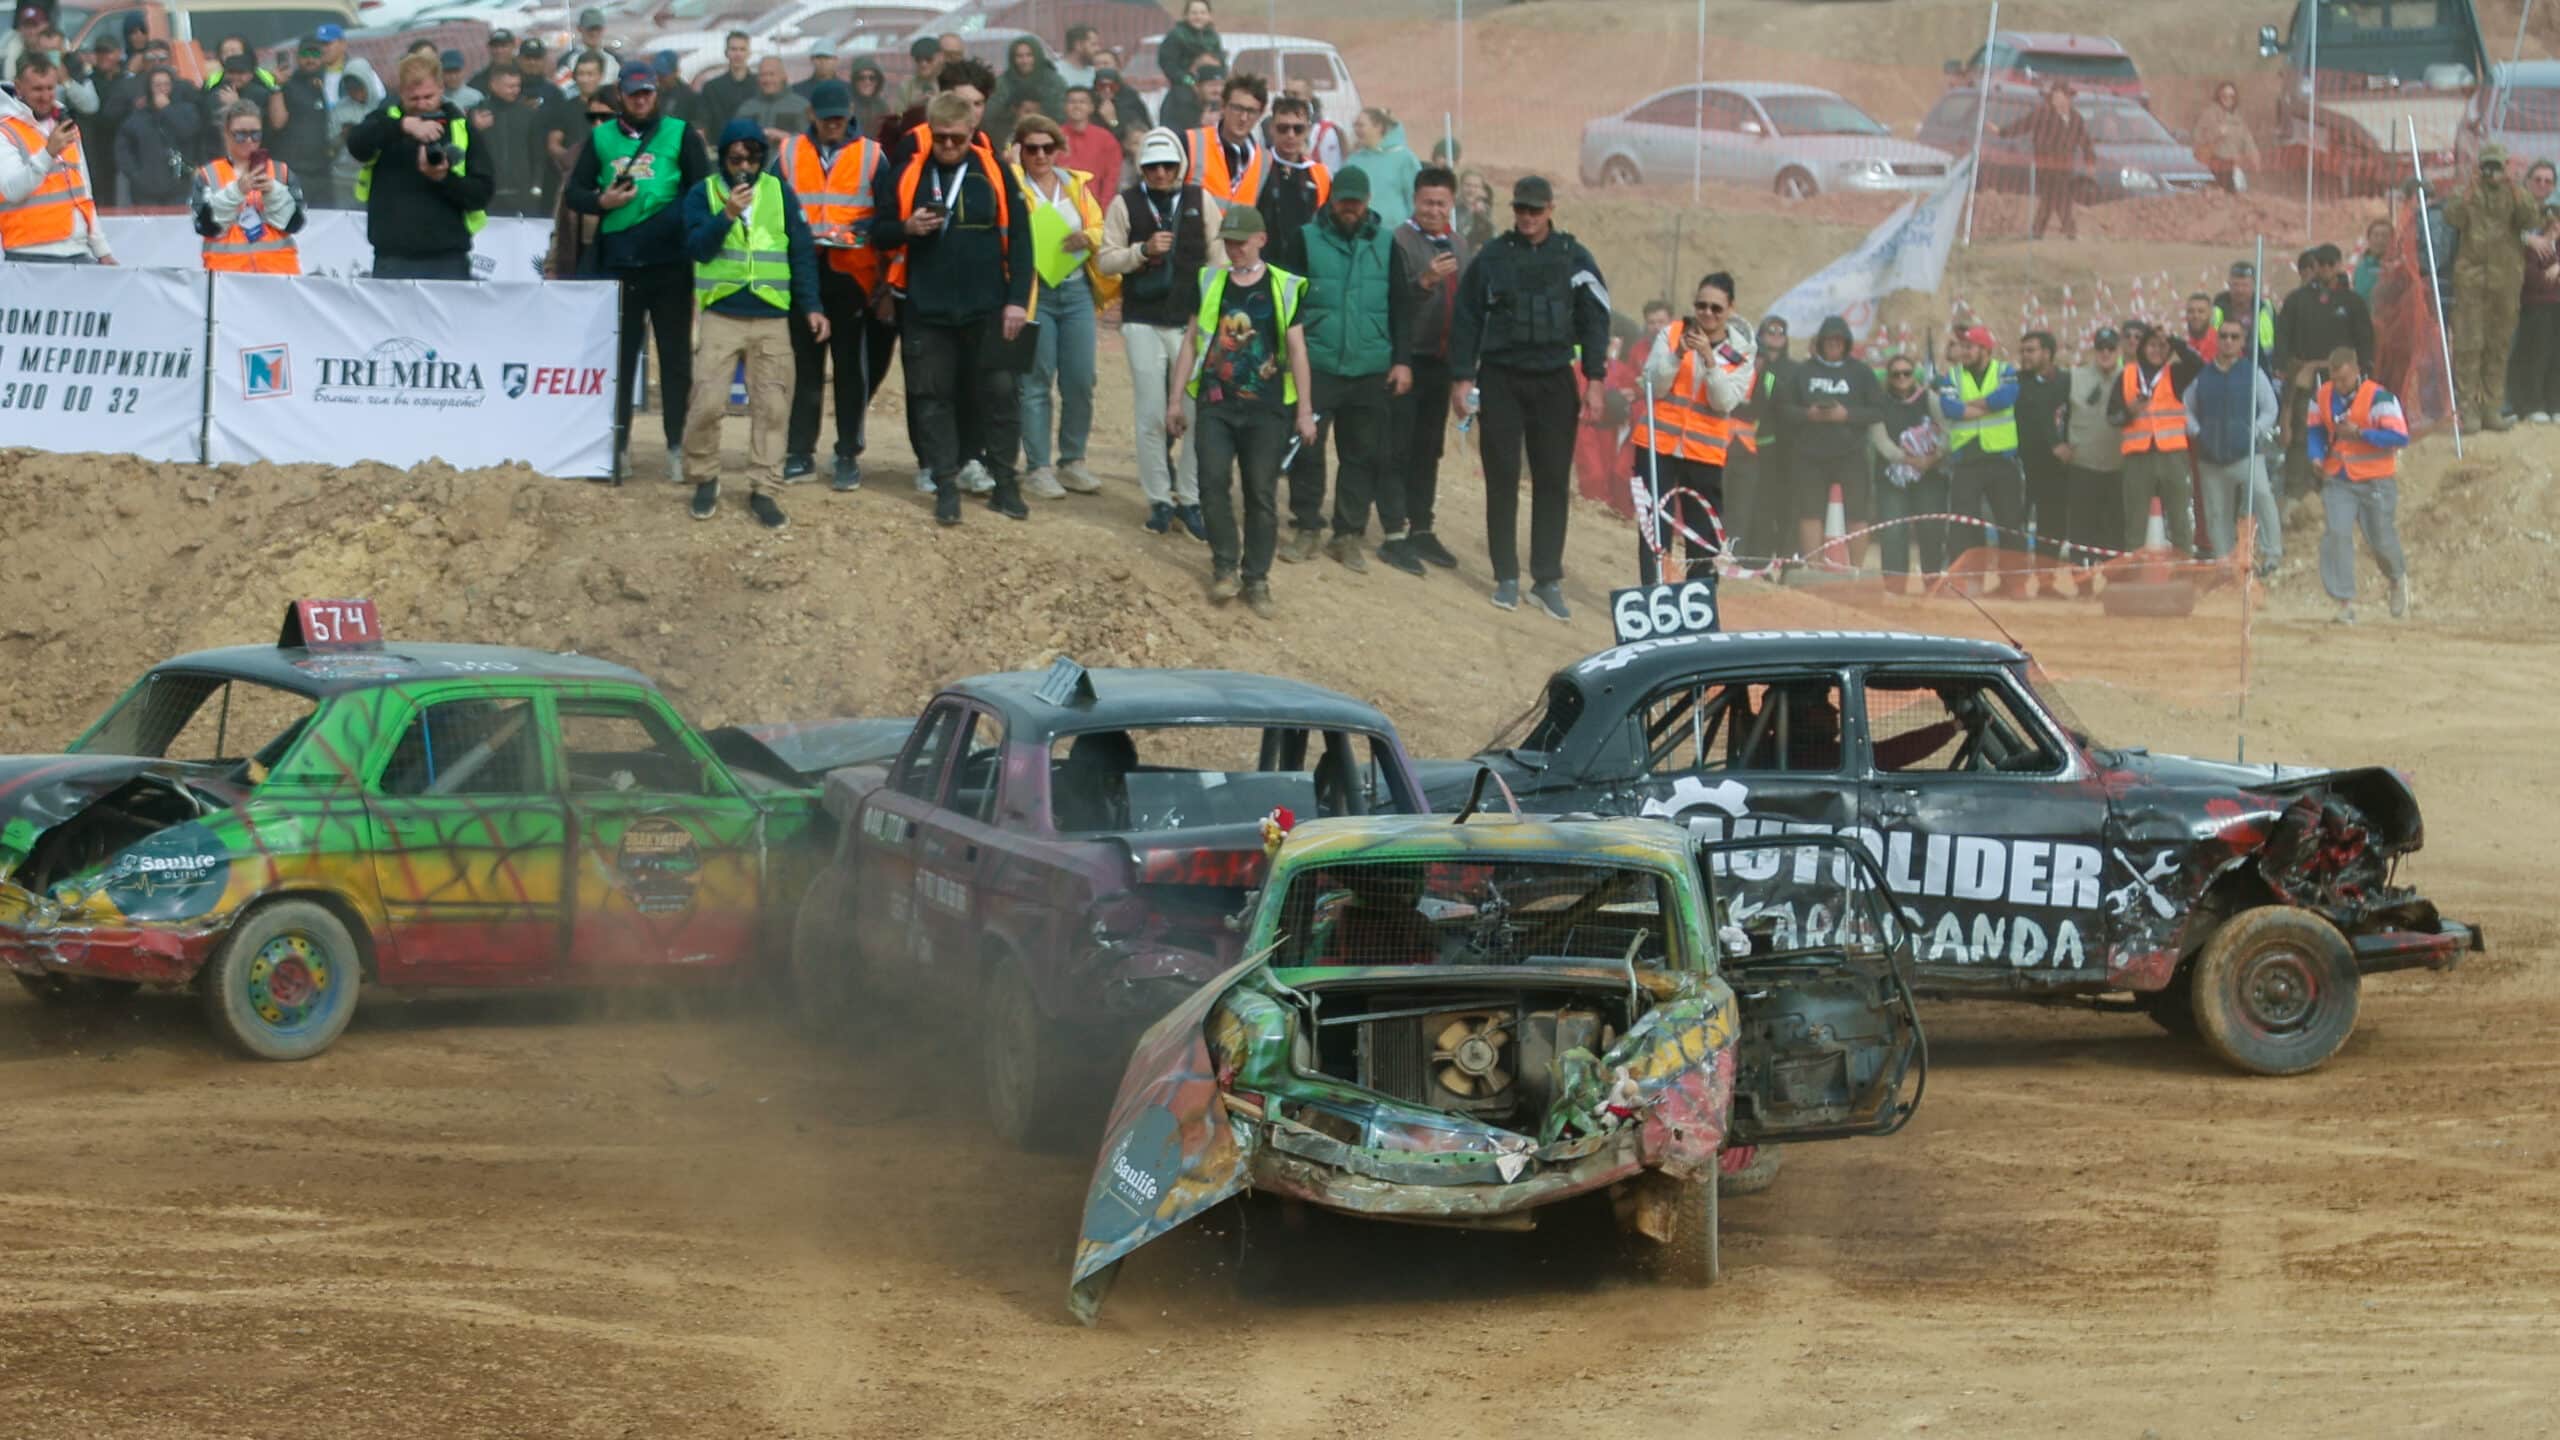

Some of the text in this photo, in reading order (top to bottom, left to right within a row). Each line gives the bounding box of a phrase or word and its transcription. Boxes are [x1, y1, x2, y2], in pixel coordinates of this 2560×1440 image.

[19, 346, 192, 379] МЕРОПРИЯТИЙ
[315, 357, 380, 387] TRI
[532, 368, 607, 395] FELIX
[1809, 377, 1849, 394] FILA
[2, 382, 139, 414] 300 00 32
[309, 606, 367, 641] 574
[1614, 583, 1714, 642] 666
[1113, 1155, 1158, 1200] Saulife
